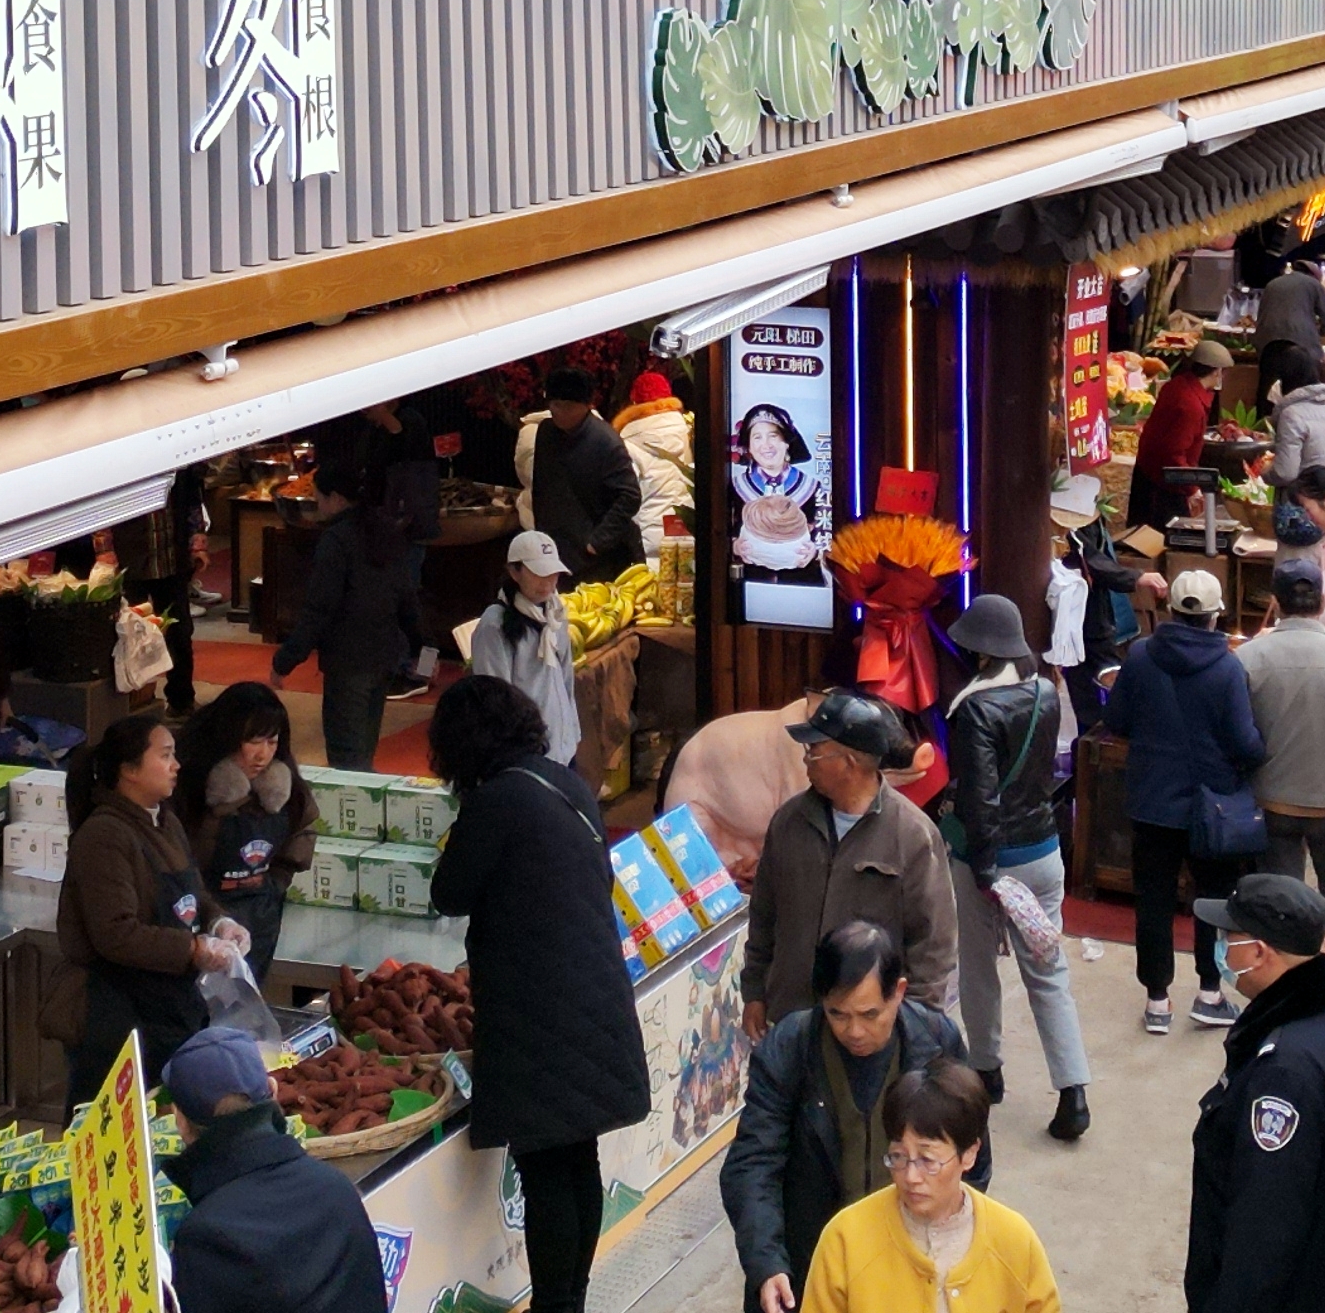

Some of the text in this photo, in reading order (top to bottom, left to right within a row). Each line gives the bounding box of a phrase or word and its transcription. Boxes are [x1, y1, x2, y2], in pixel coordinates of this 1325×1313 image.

[749, 354, 817, 375] 纯手工制作
